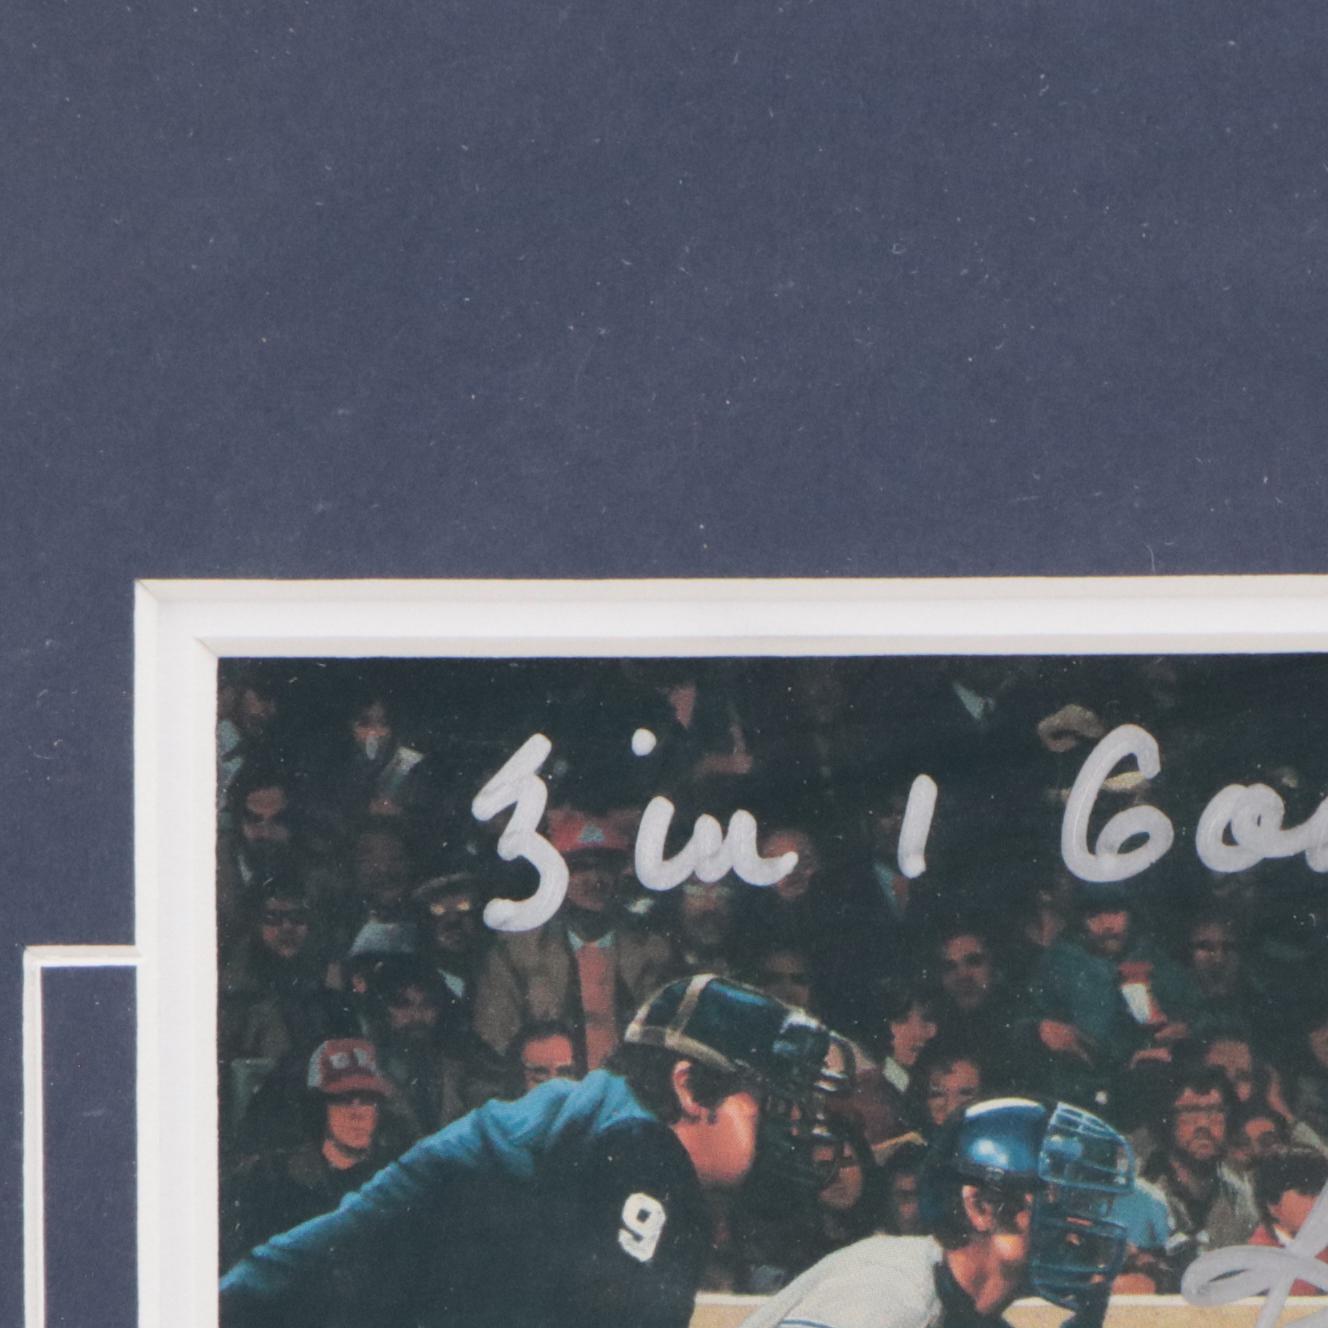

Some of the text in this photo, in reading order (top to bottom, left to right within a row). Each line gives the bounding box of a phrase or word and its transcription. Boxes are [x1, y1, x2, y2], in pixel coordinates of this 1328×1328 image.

[472, 732, 569, 932] 3
[633, 727, 800, 891] in
[898, 773, 938, 878] 1
[617, 1192, 667, 1263] 9
